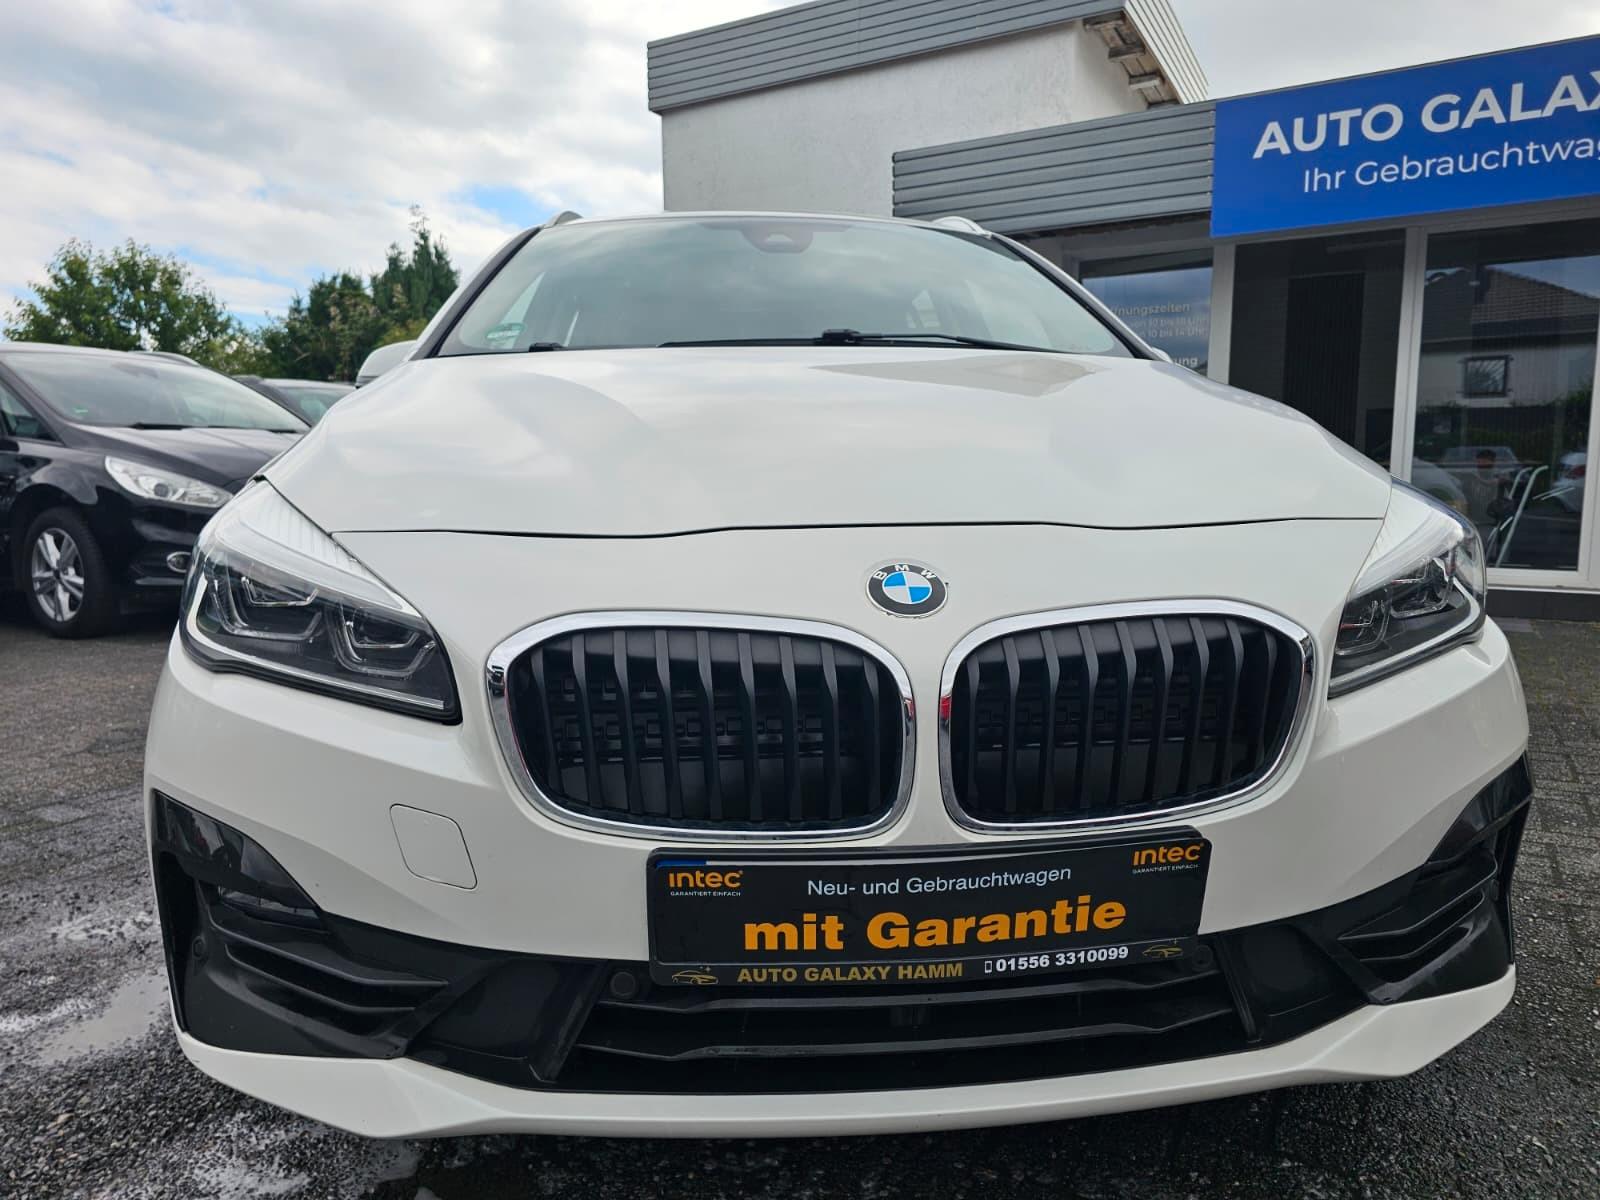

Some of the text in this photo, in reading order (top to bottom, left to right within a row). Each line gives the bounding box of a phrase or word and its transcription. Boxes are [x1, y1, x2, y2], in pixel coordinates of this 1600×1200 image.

[1253, 103, 1404, 159] AUTO
[1303, 138, 1600, 193] Ihr Gebrauchtwa
[873, 564, 936, 580] BMW
[1133, 845, 1201, 866] intec
[668, 870, 742, 888] intec
[1132, 865, 1171, 874] GARANTIERT
[808, 867, 1072, 896] Neu- und Gebrauchtwagen
[745, 895, 1127, 950] mit Garantie
[996, 946, 1129, 972] 01556 3310099
[737, 963, 963, 983] AUTO GALAXY HAMM
